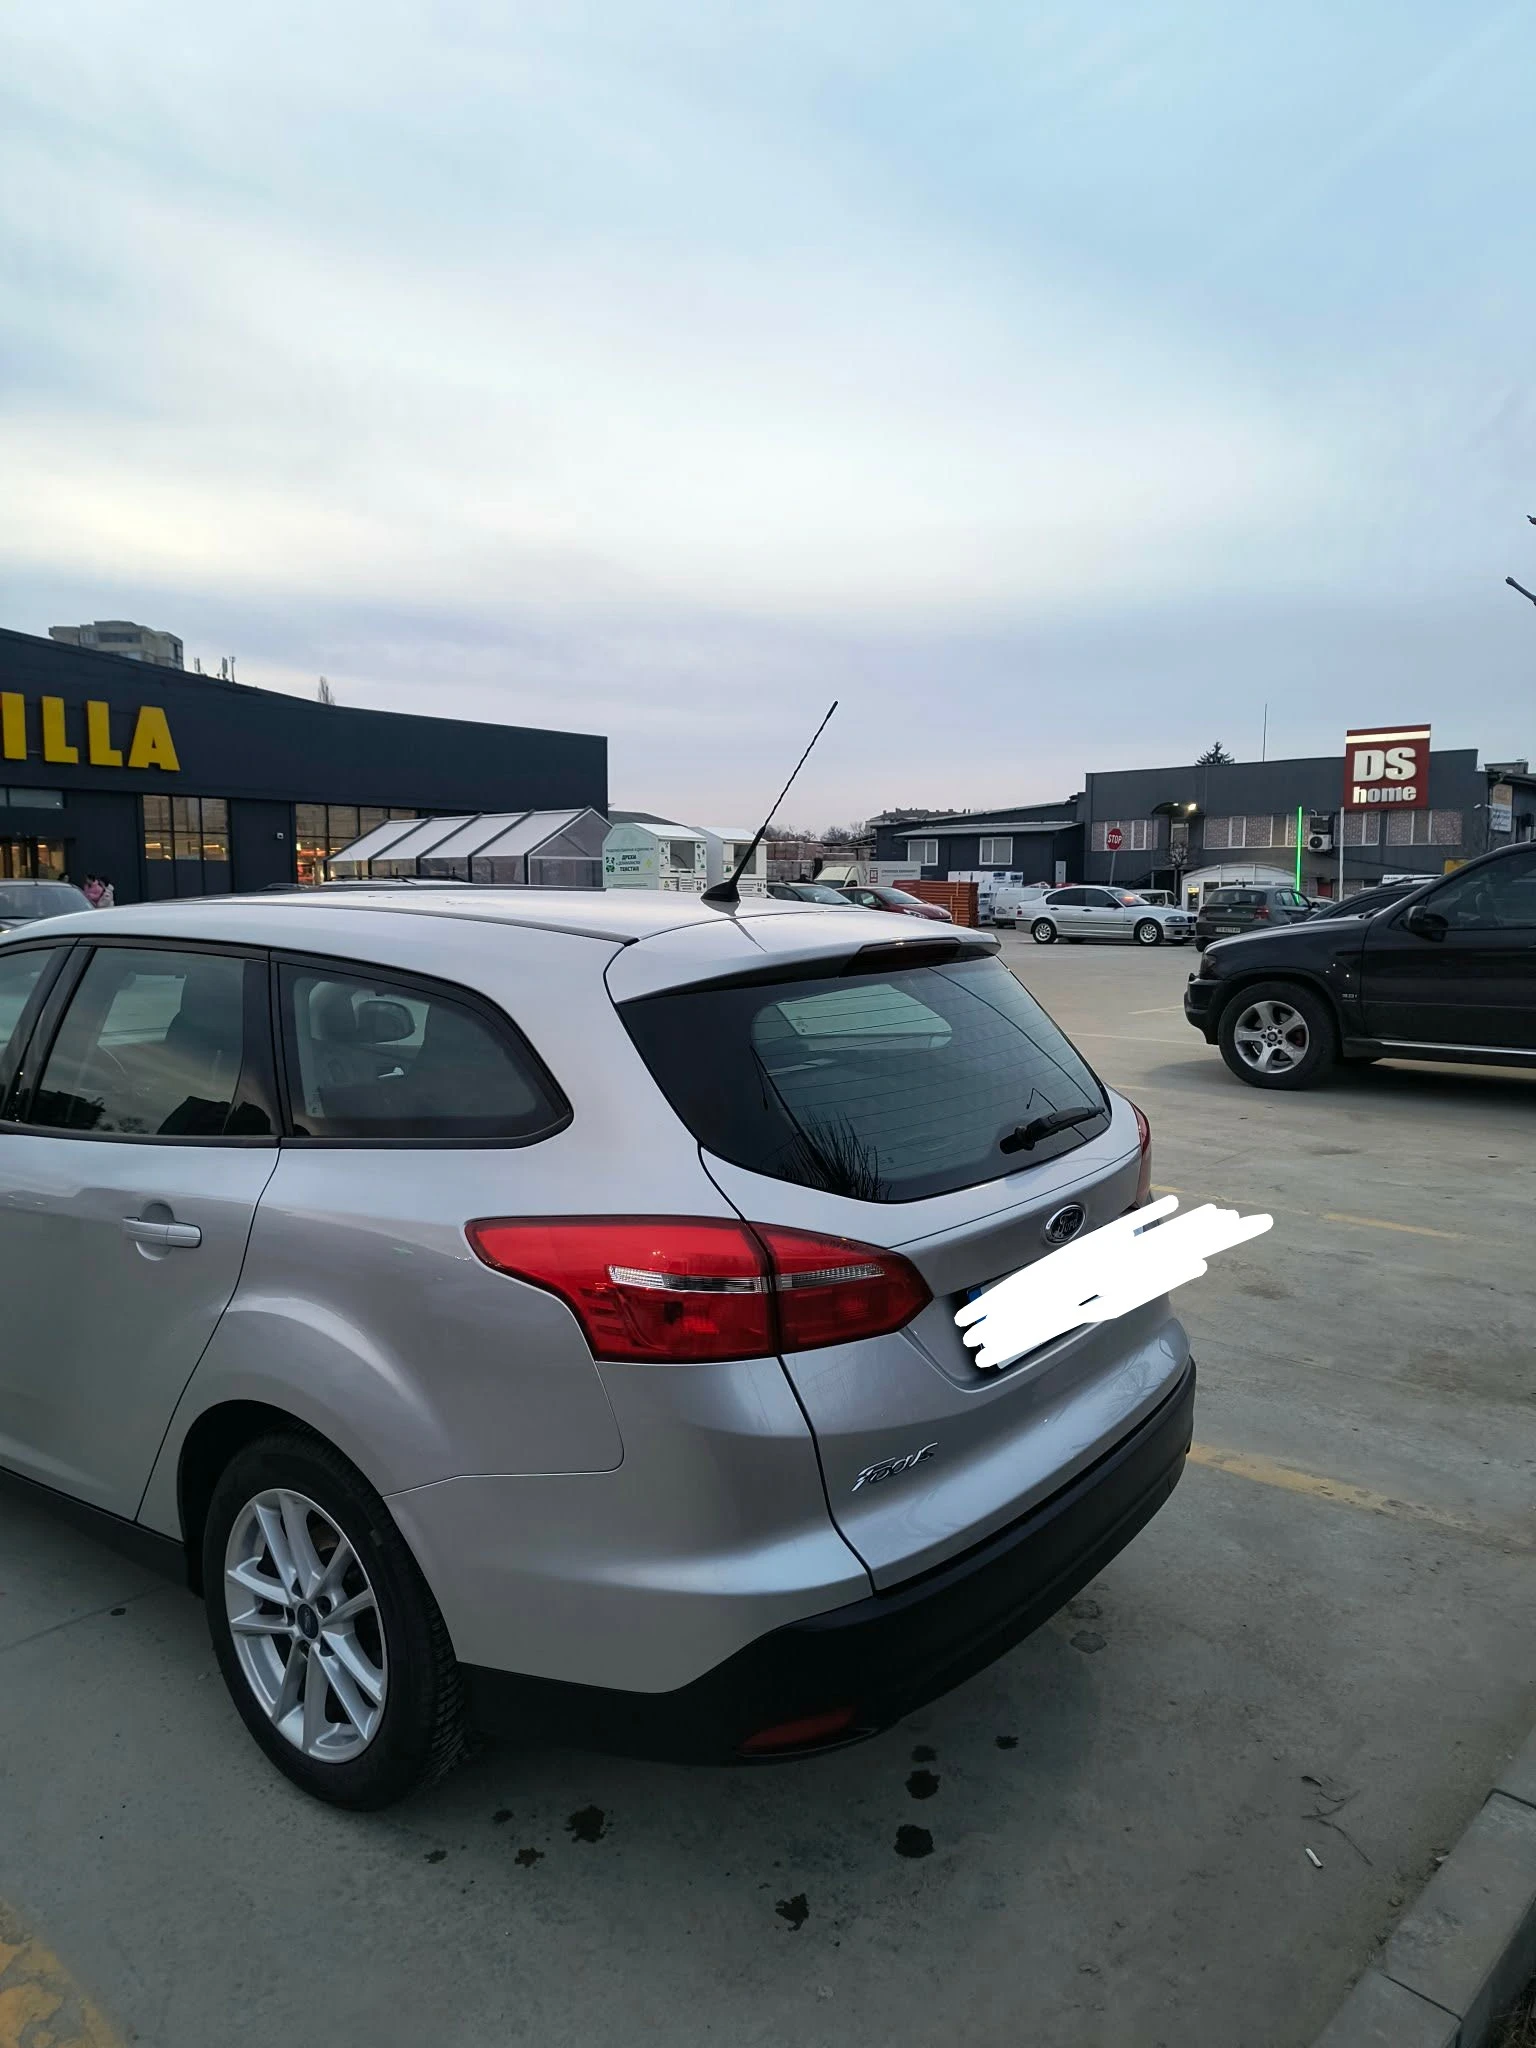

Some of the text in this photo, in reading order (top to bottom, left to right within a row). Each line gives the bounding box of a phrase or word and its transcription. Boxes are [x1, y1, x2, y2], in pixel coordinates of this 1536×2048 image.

[0, 691, 181, 772] ILLA
[1353, 747, 1417, 782] DS
[1352, 786, 1417, 804] home
[1107, 834, 1123, 845] STOP
